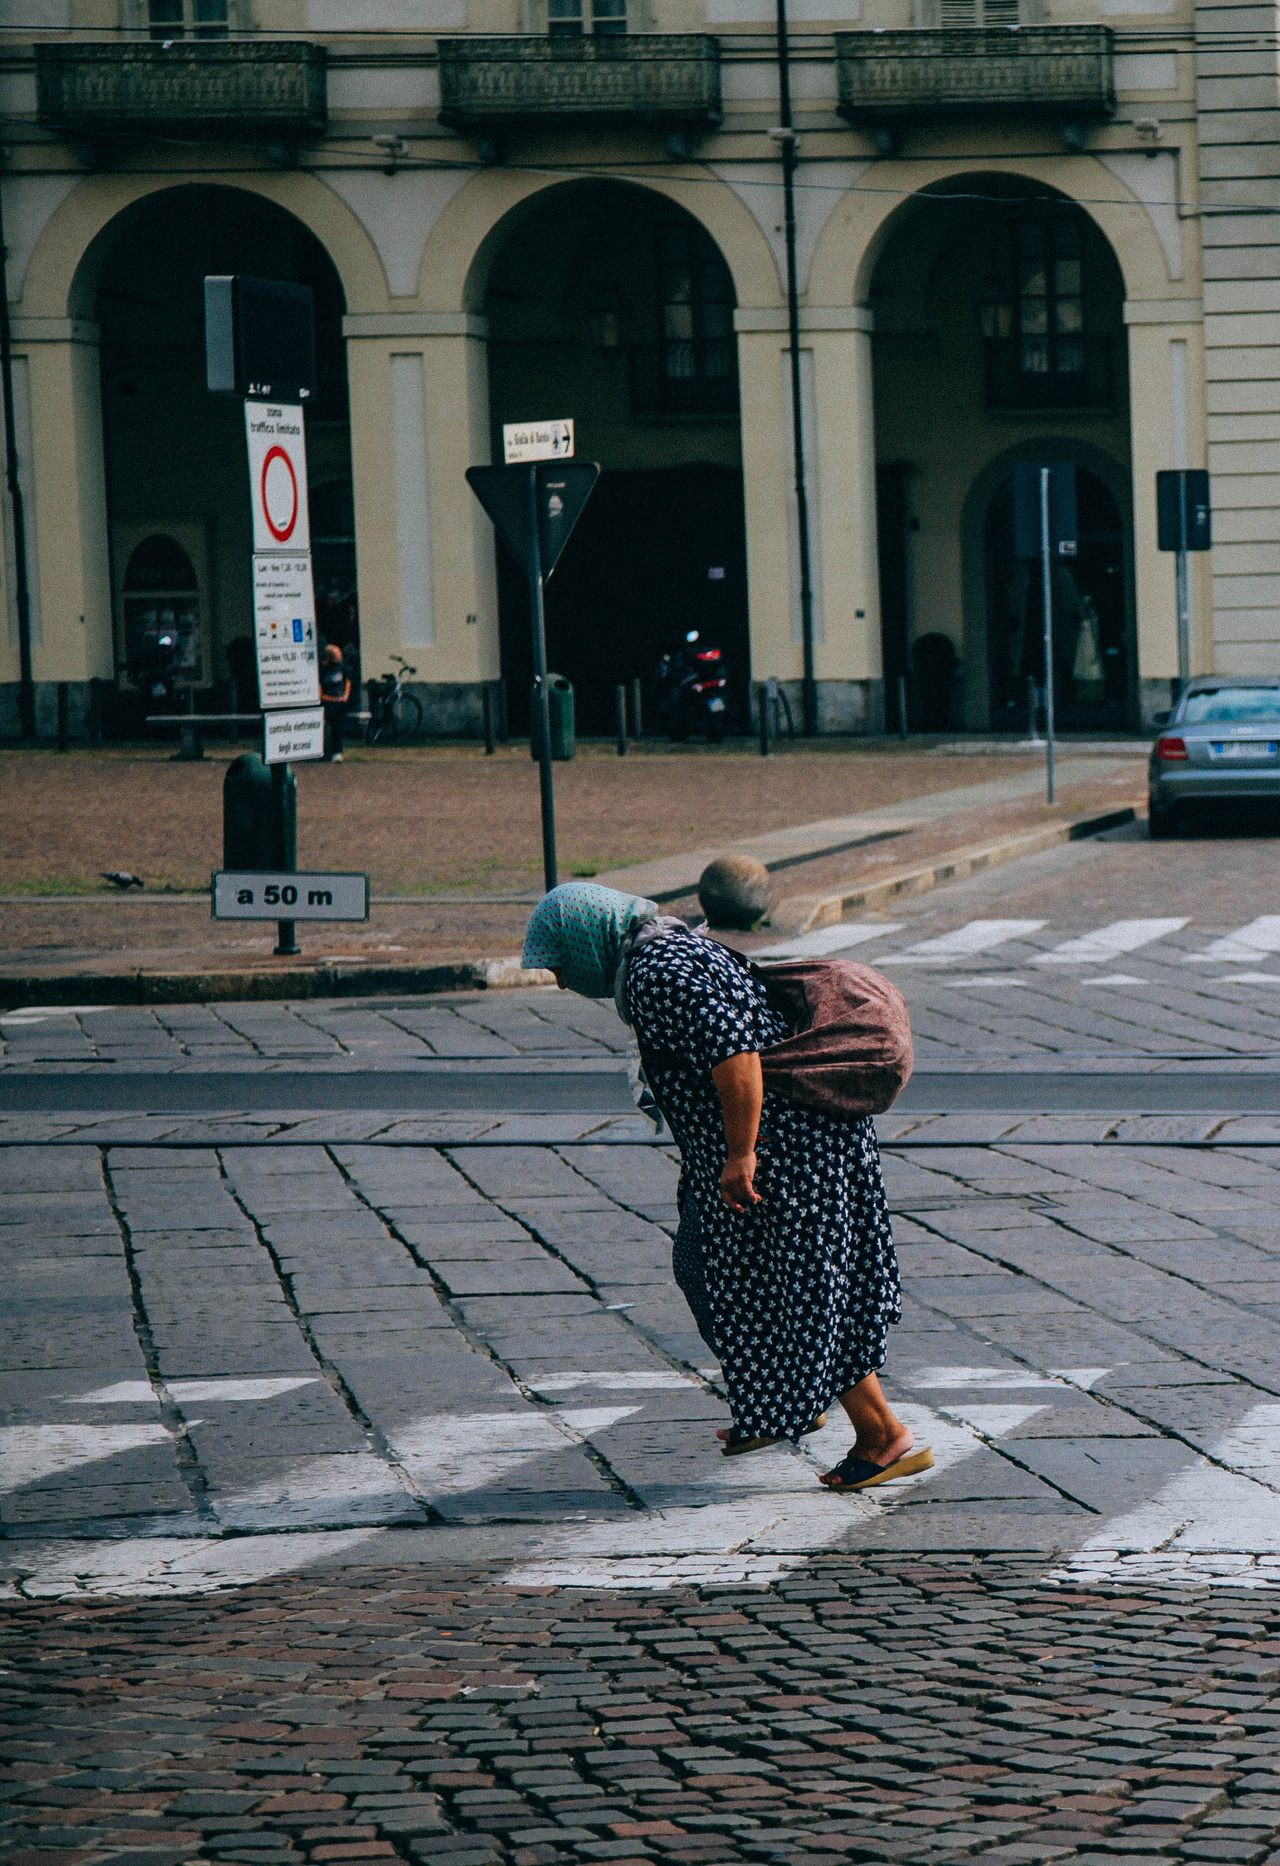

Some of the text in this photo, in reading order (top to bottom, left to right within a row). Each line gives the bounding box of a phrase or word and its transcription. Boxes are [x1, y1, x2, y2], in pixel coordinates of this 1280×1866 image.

[250, 421, 300, 435] traffico limitato
[237, 885, 333, 906] a 50 m
